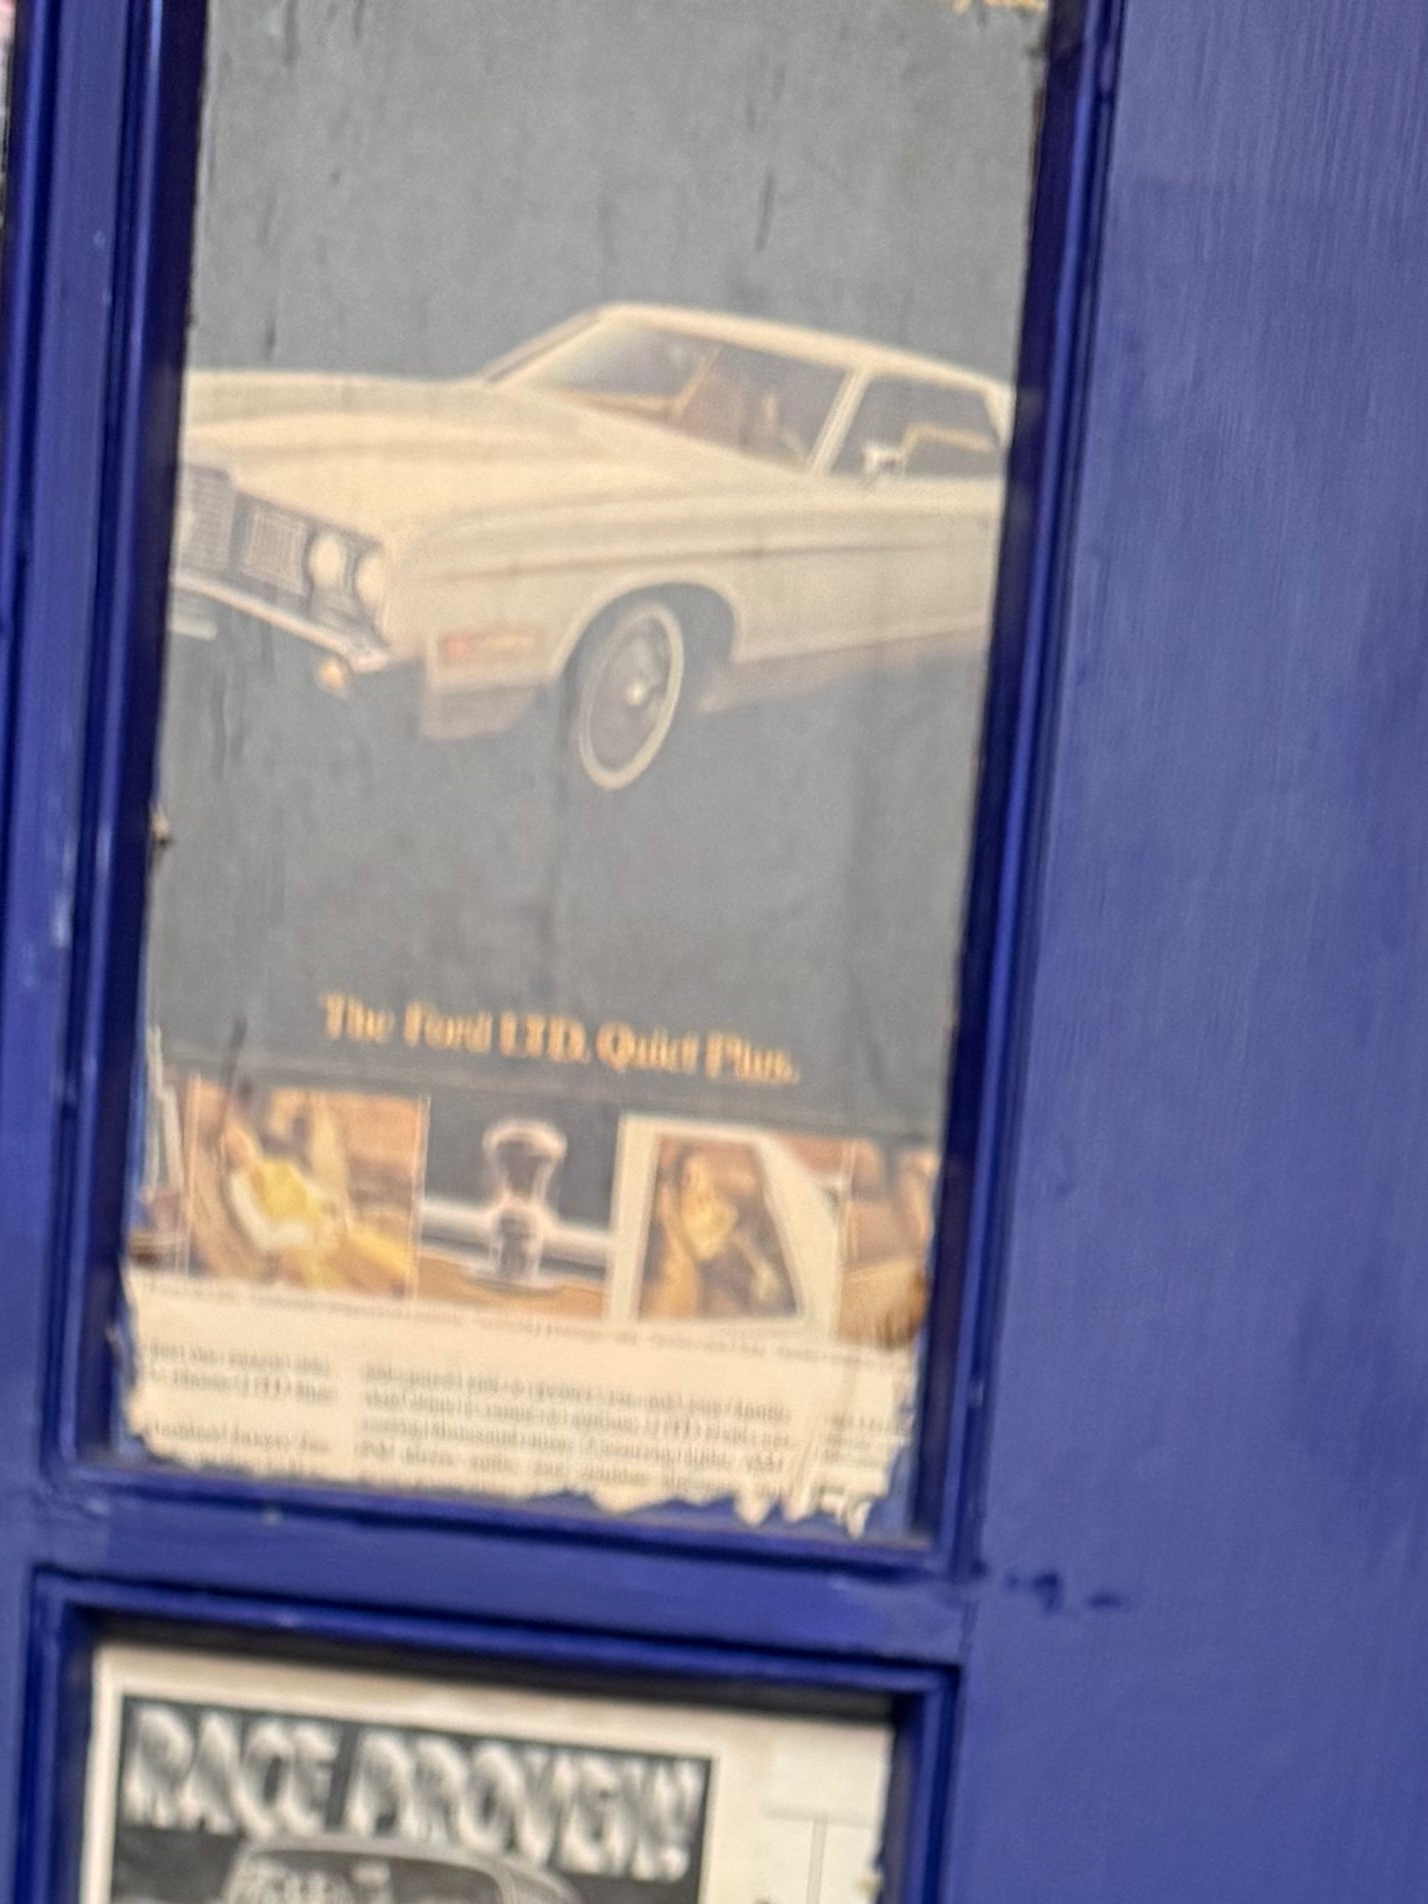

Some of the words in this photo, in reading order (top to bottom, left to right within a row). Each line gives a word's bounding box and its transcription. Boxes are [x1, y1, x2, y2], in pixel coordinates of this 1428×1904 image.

[320, 992, 394, 1044] The
[404, 1001, 492, 1055] Ford
[596, 1020, 699, 1074] Quiet
